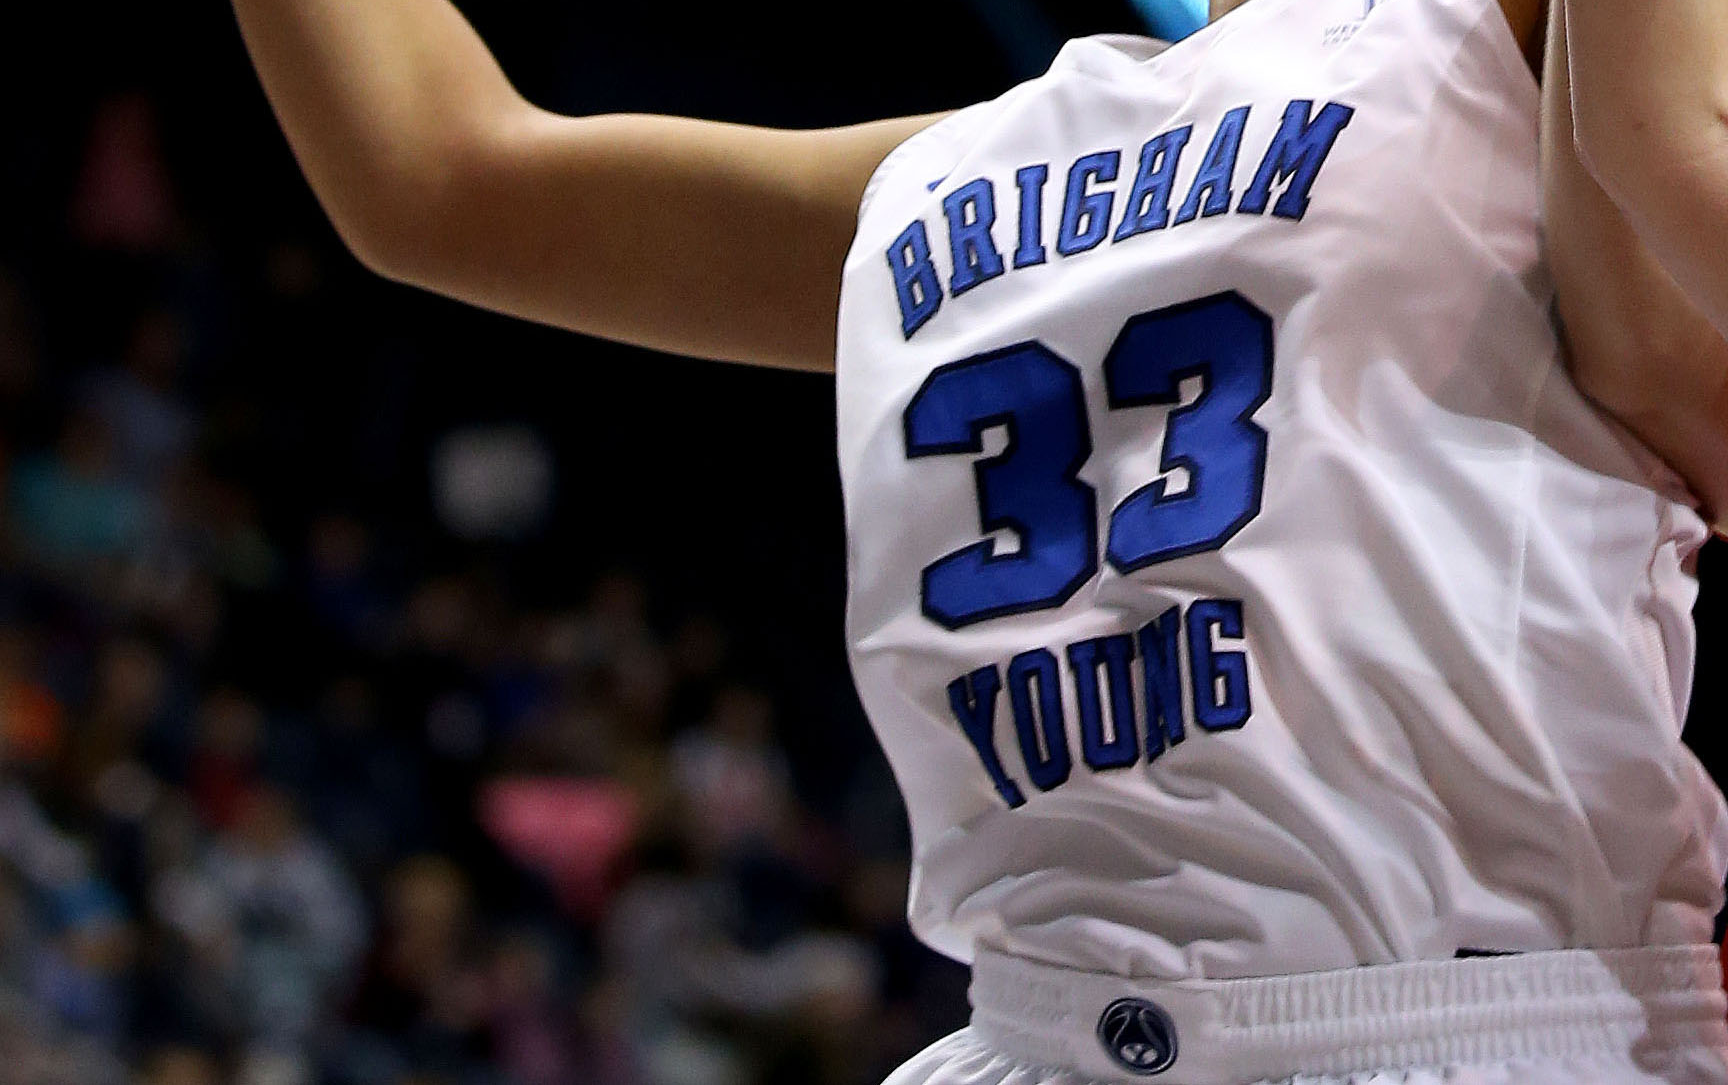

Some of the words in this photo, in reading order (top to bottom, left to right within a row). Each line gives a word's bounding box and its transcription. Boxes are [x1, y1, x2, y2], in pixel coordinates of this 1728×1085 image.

[885, 98, 1355, 342] BRIGHAM
[903, 289, 1276, 633] 33
[947, 598, 1253, 811] YOUNG
